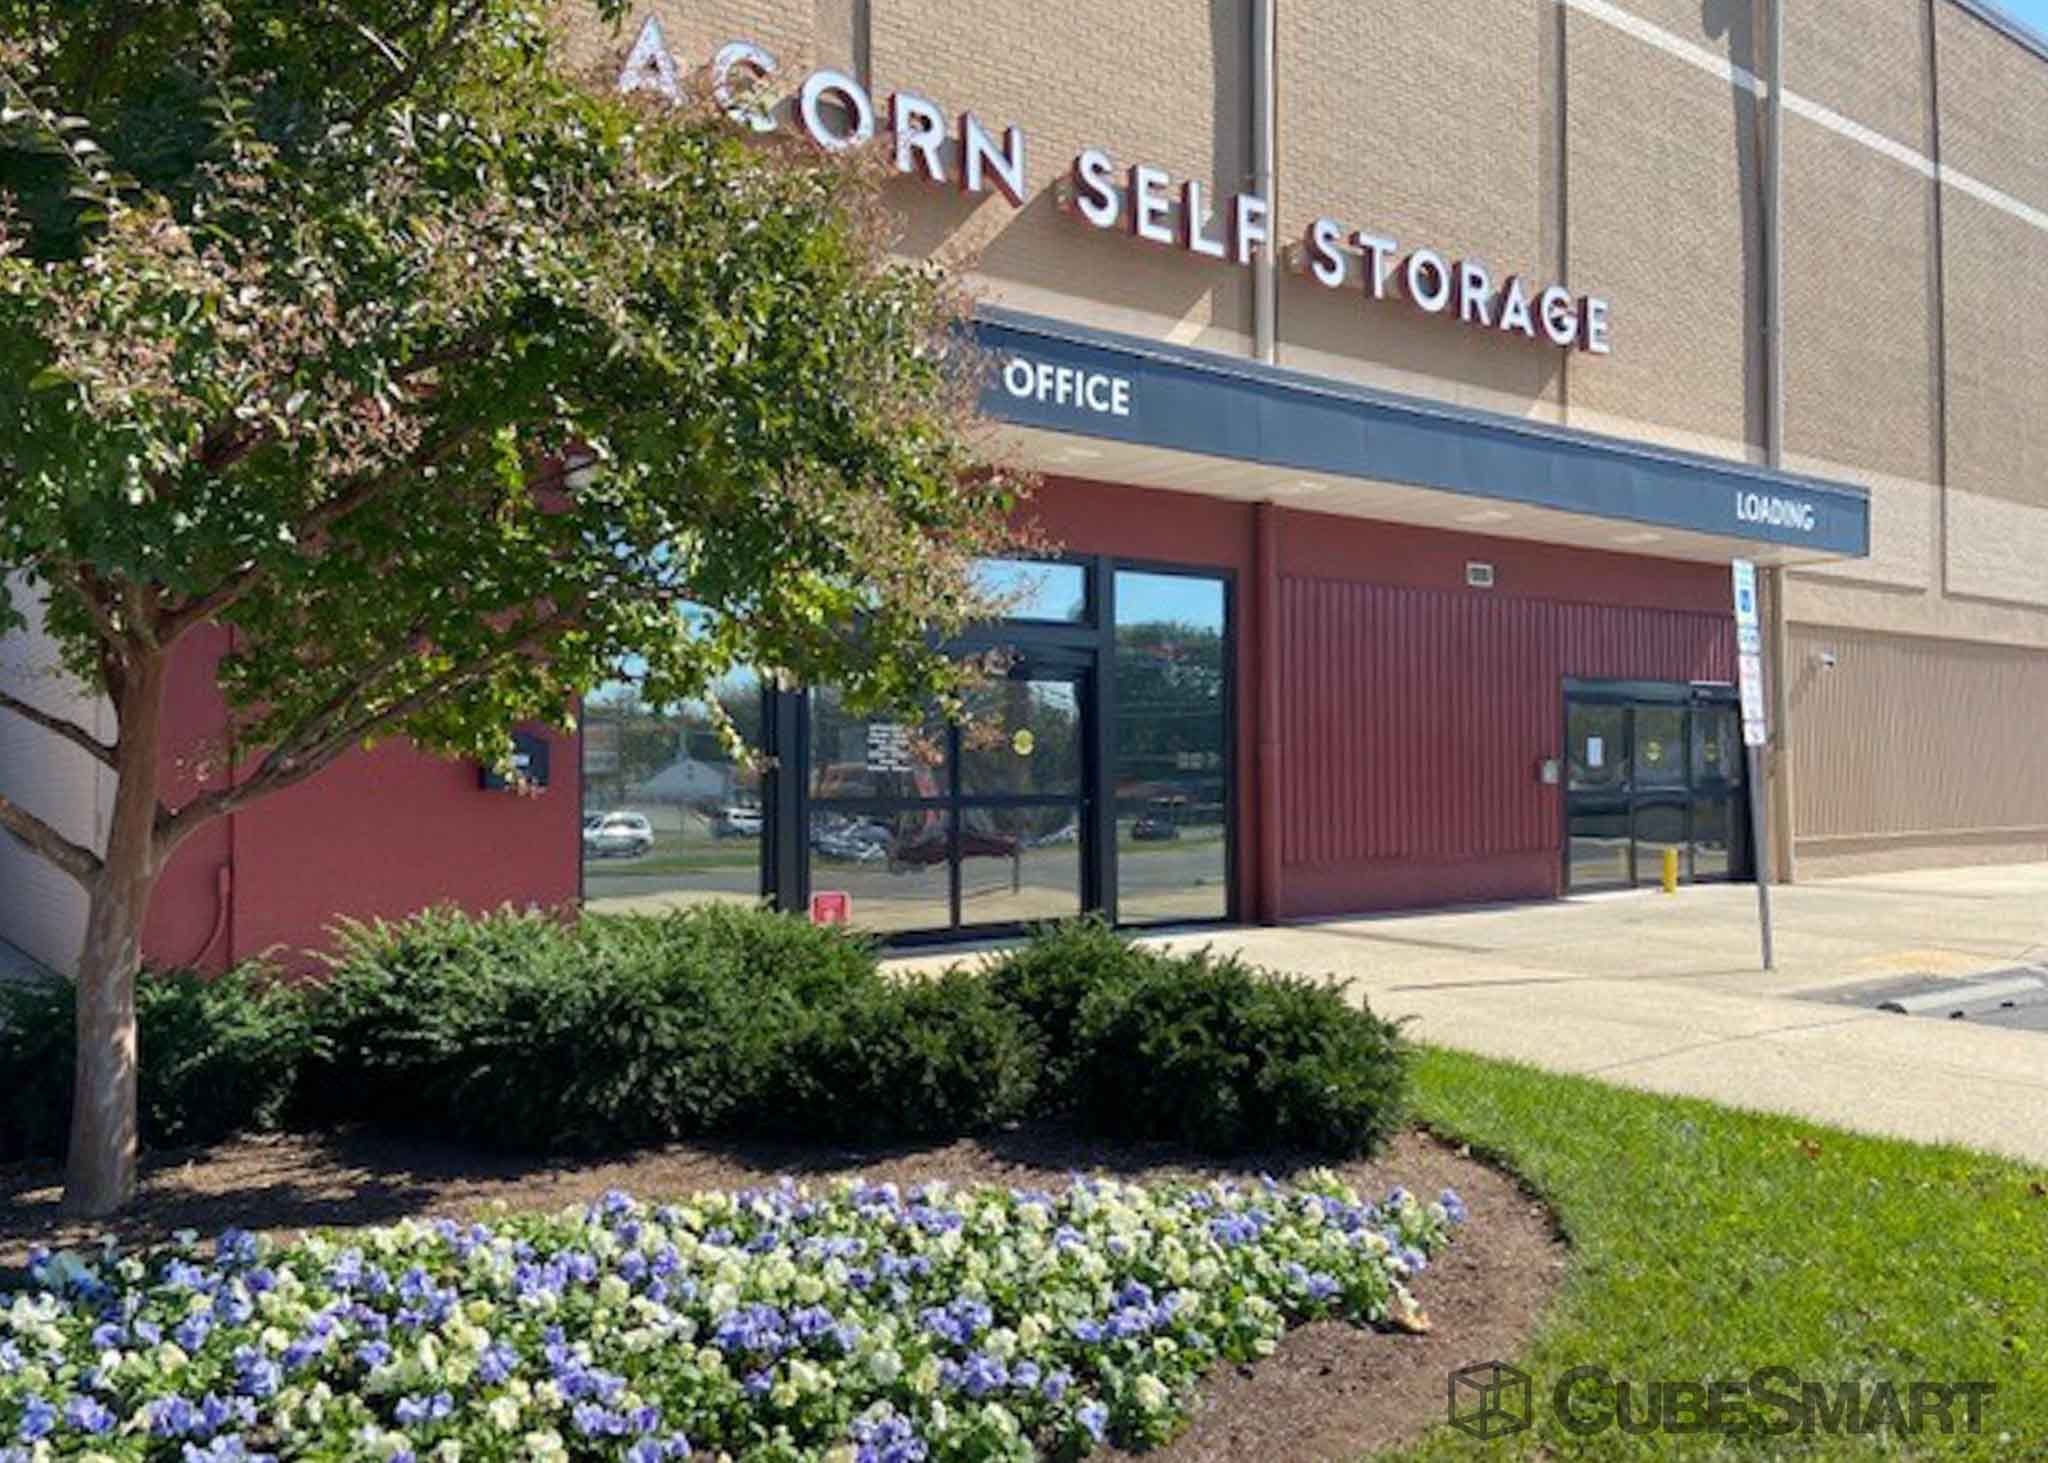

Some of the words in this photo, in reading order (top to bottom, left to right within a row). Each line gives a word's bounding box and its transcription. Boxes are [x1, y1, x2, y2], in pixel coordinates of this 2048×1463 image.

[618, 15, 1027, 207] ACORN
[1074, 148, 1269, 264] SELF
[1306, 215, 1612, 354] STORAGE
[1004, 358, 1131, 416] OFFICE
[1736, 492, 1814, 531] LOADING
